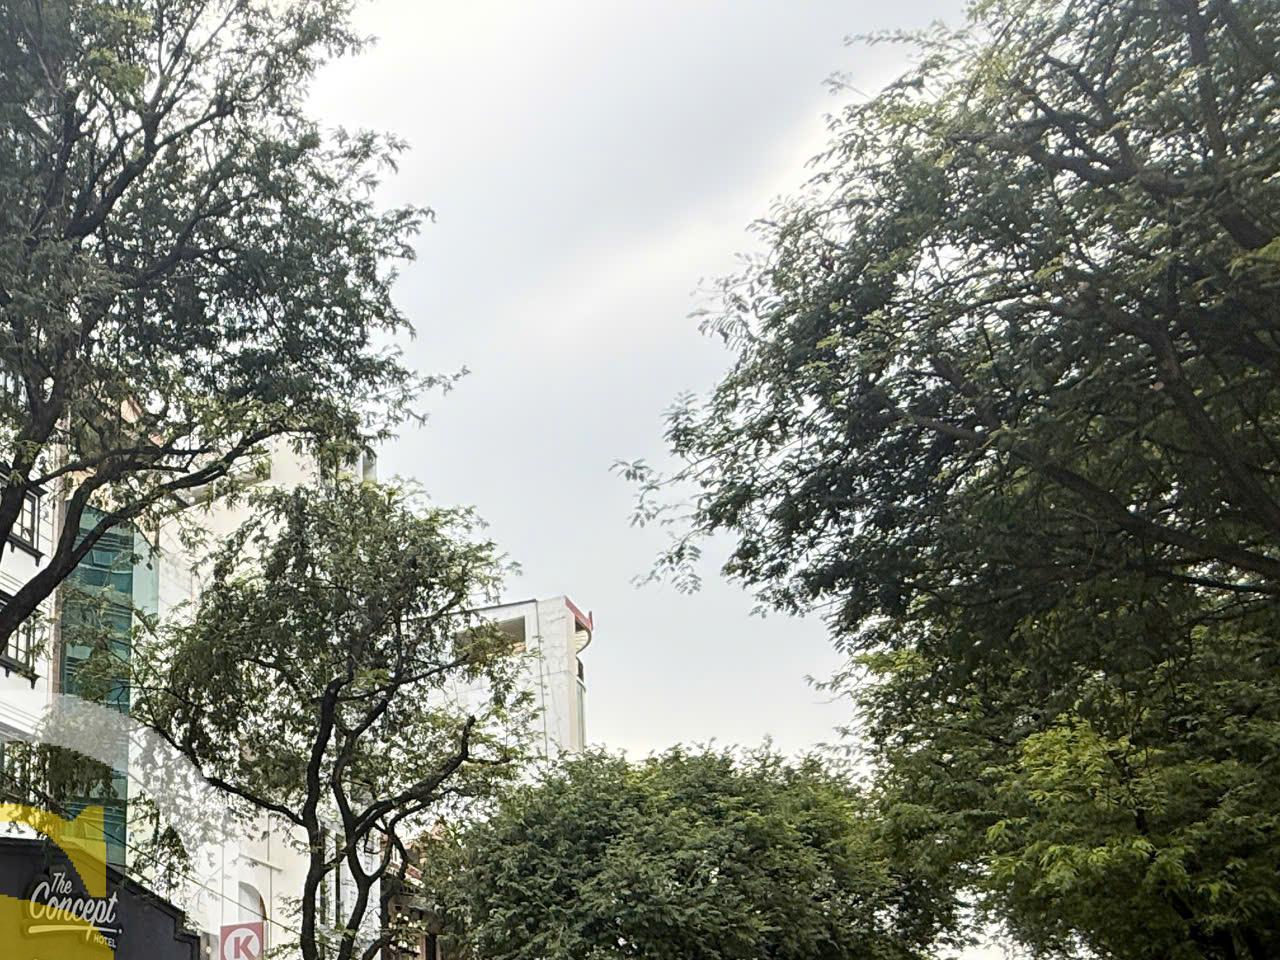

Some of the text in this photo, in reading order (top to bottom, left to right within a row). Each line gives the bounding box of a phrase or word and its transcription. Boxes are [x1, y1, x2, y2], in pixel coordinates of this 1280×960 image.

[50, 871, 73, 894] The
[29, 881, 119, 941] Concept
[92, 933, 117, 948] HOTEL
